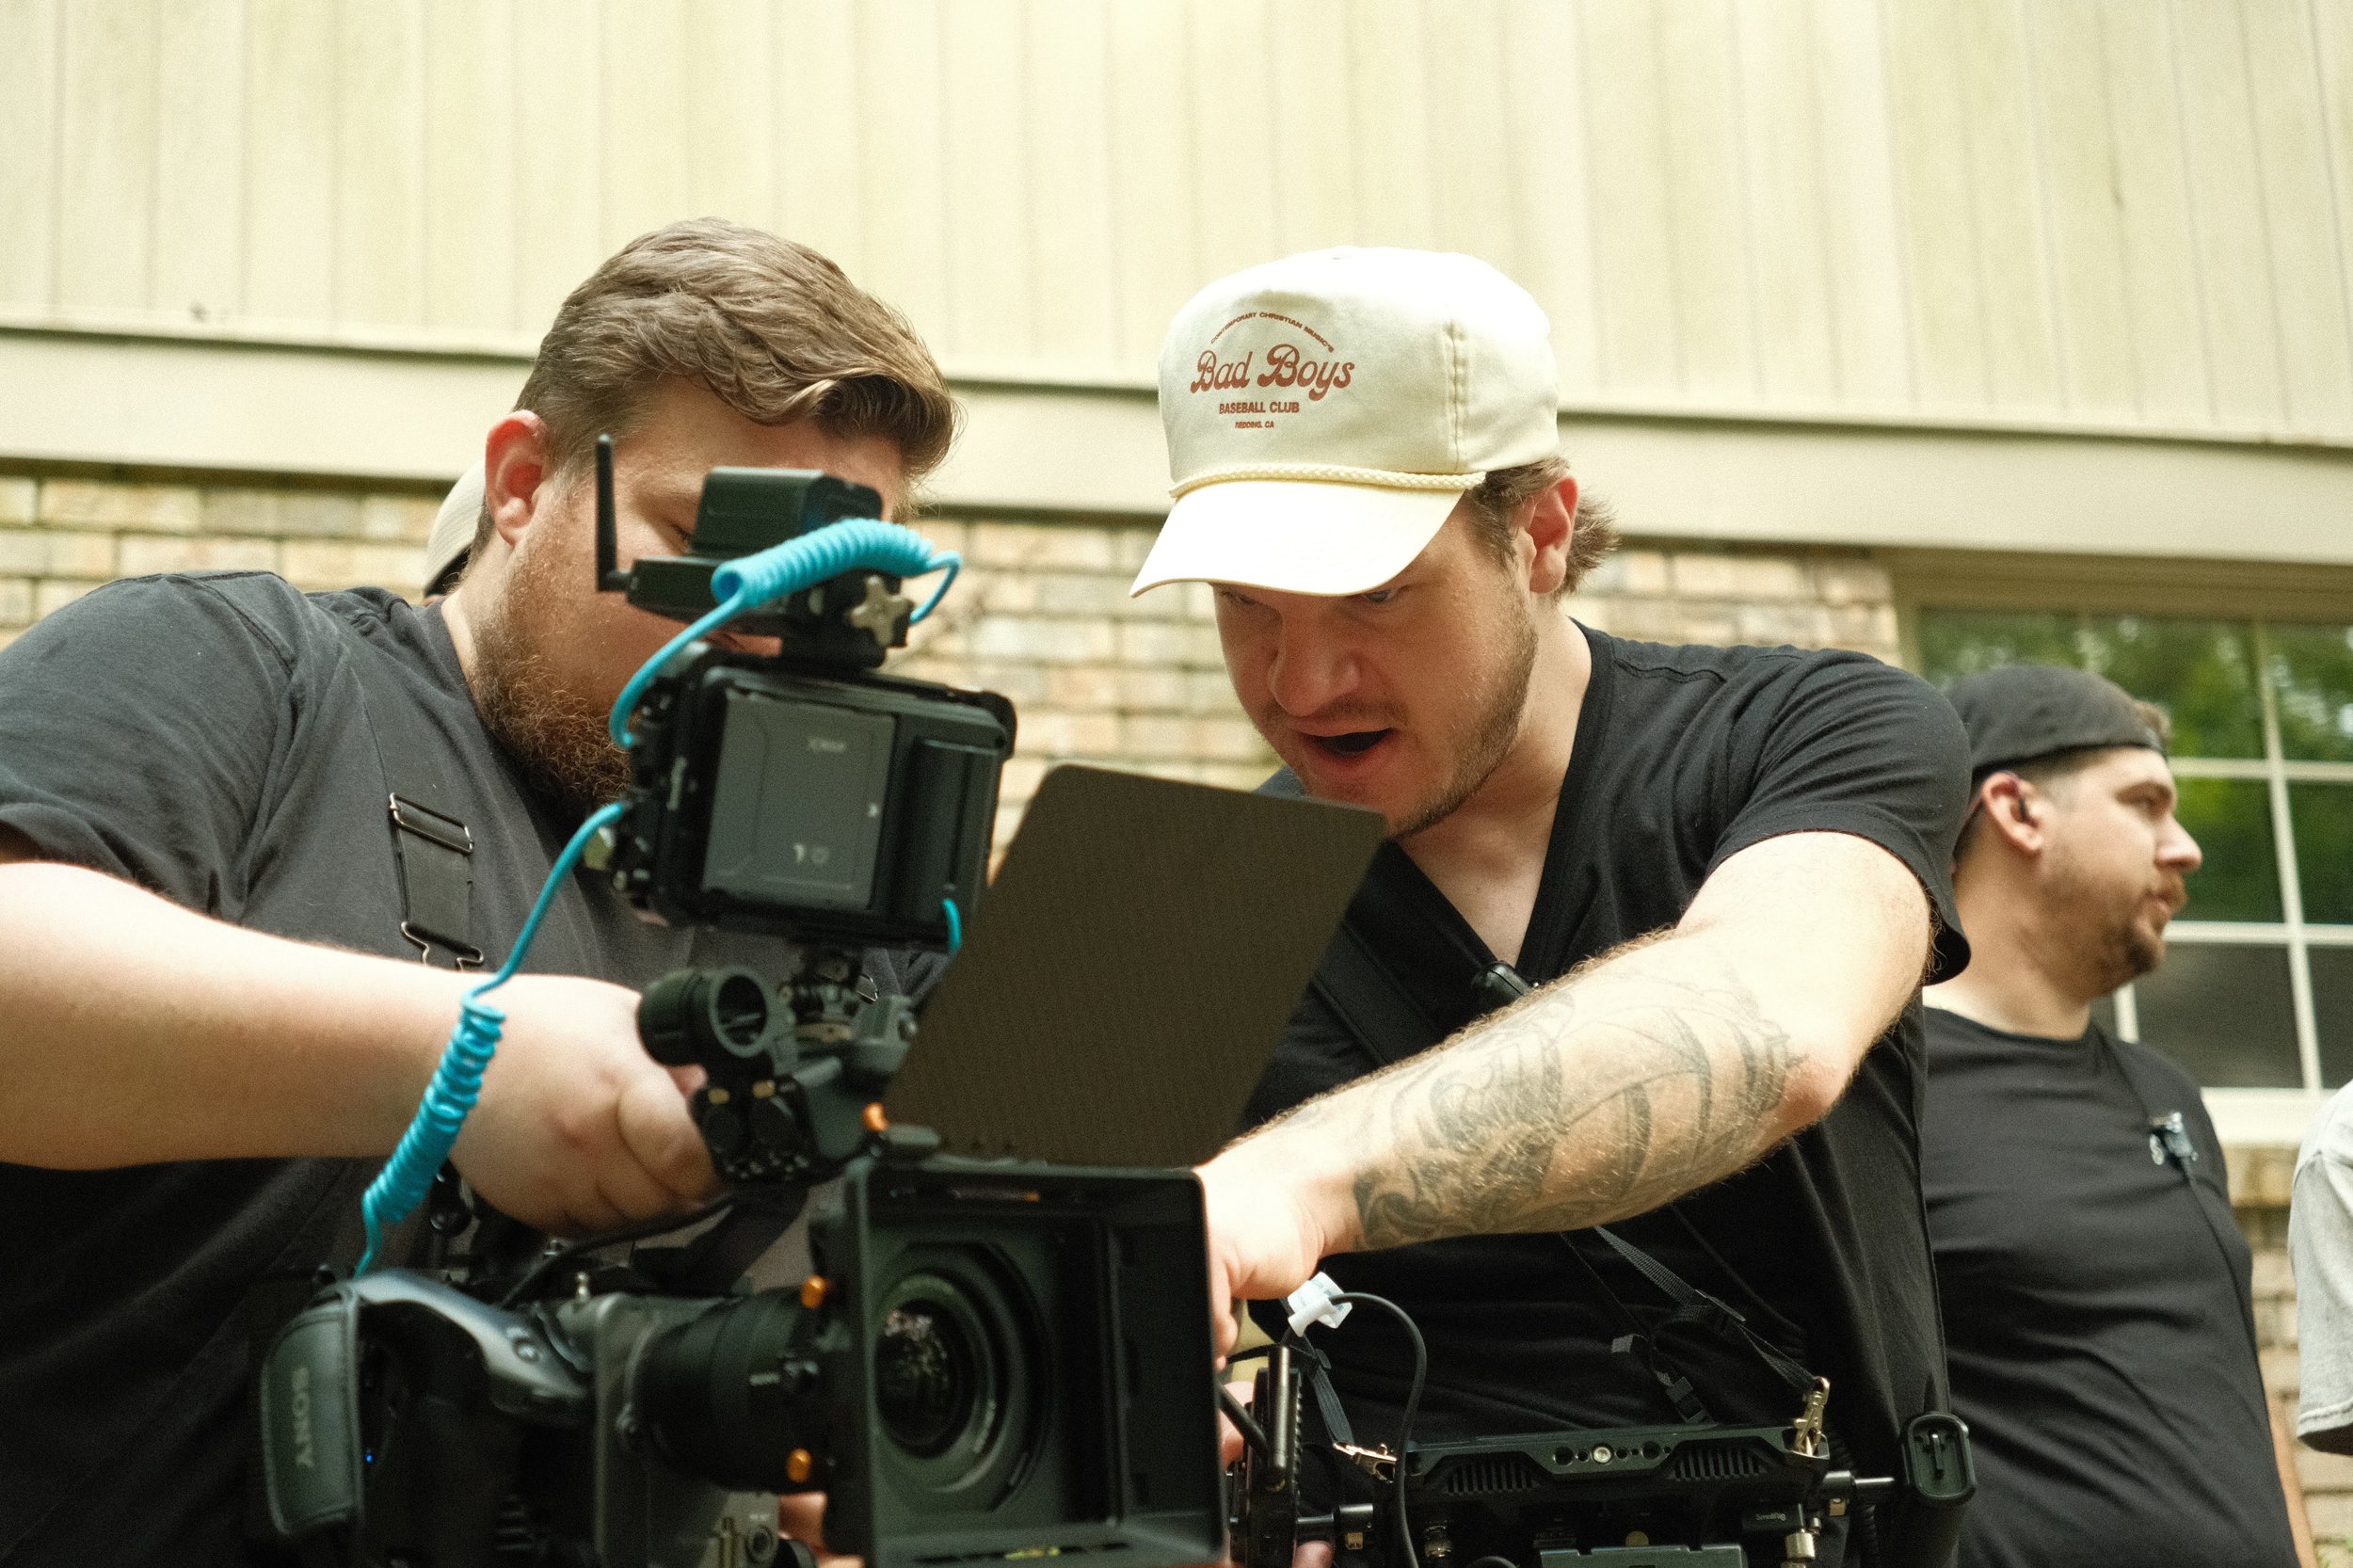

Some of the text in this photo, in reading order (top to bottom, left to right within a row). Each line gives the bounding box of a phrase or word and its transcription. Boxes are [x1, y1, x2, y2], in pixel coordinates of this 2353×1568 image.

[1259, 312, 1303, 328] CHRISTIAN
[1190, 344, 1355, 401] Bad Boys
[1219, 401, 1300, 414] BASEBALL CLUB
[291, 1367, 314, 1468] SONY
